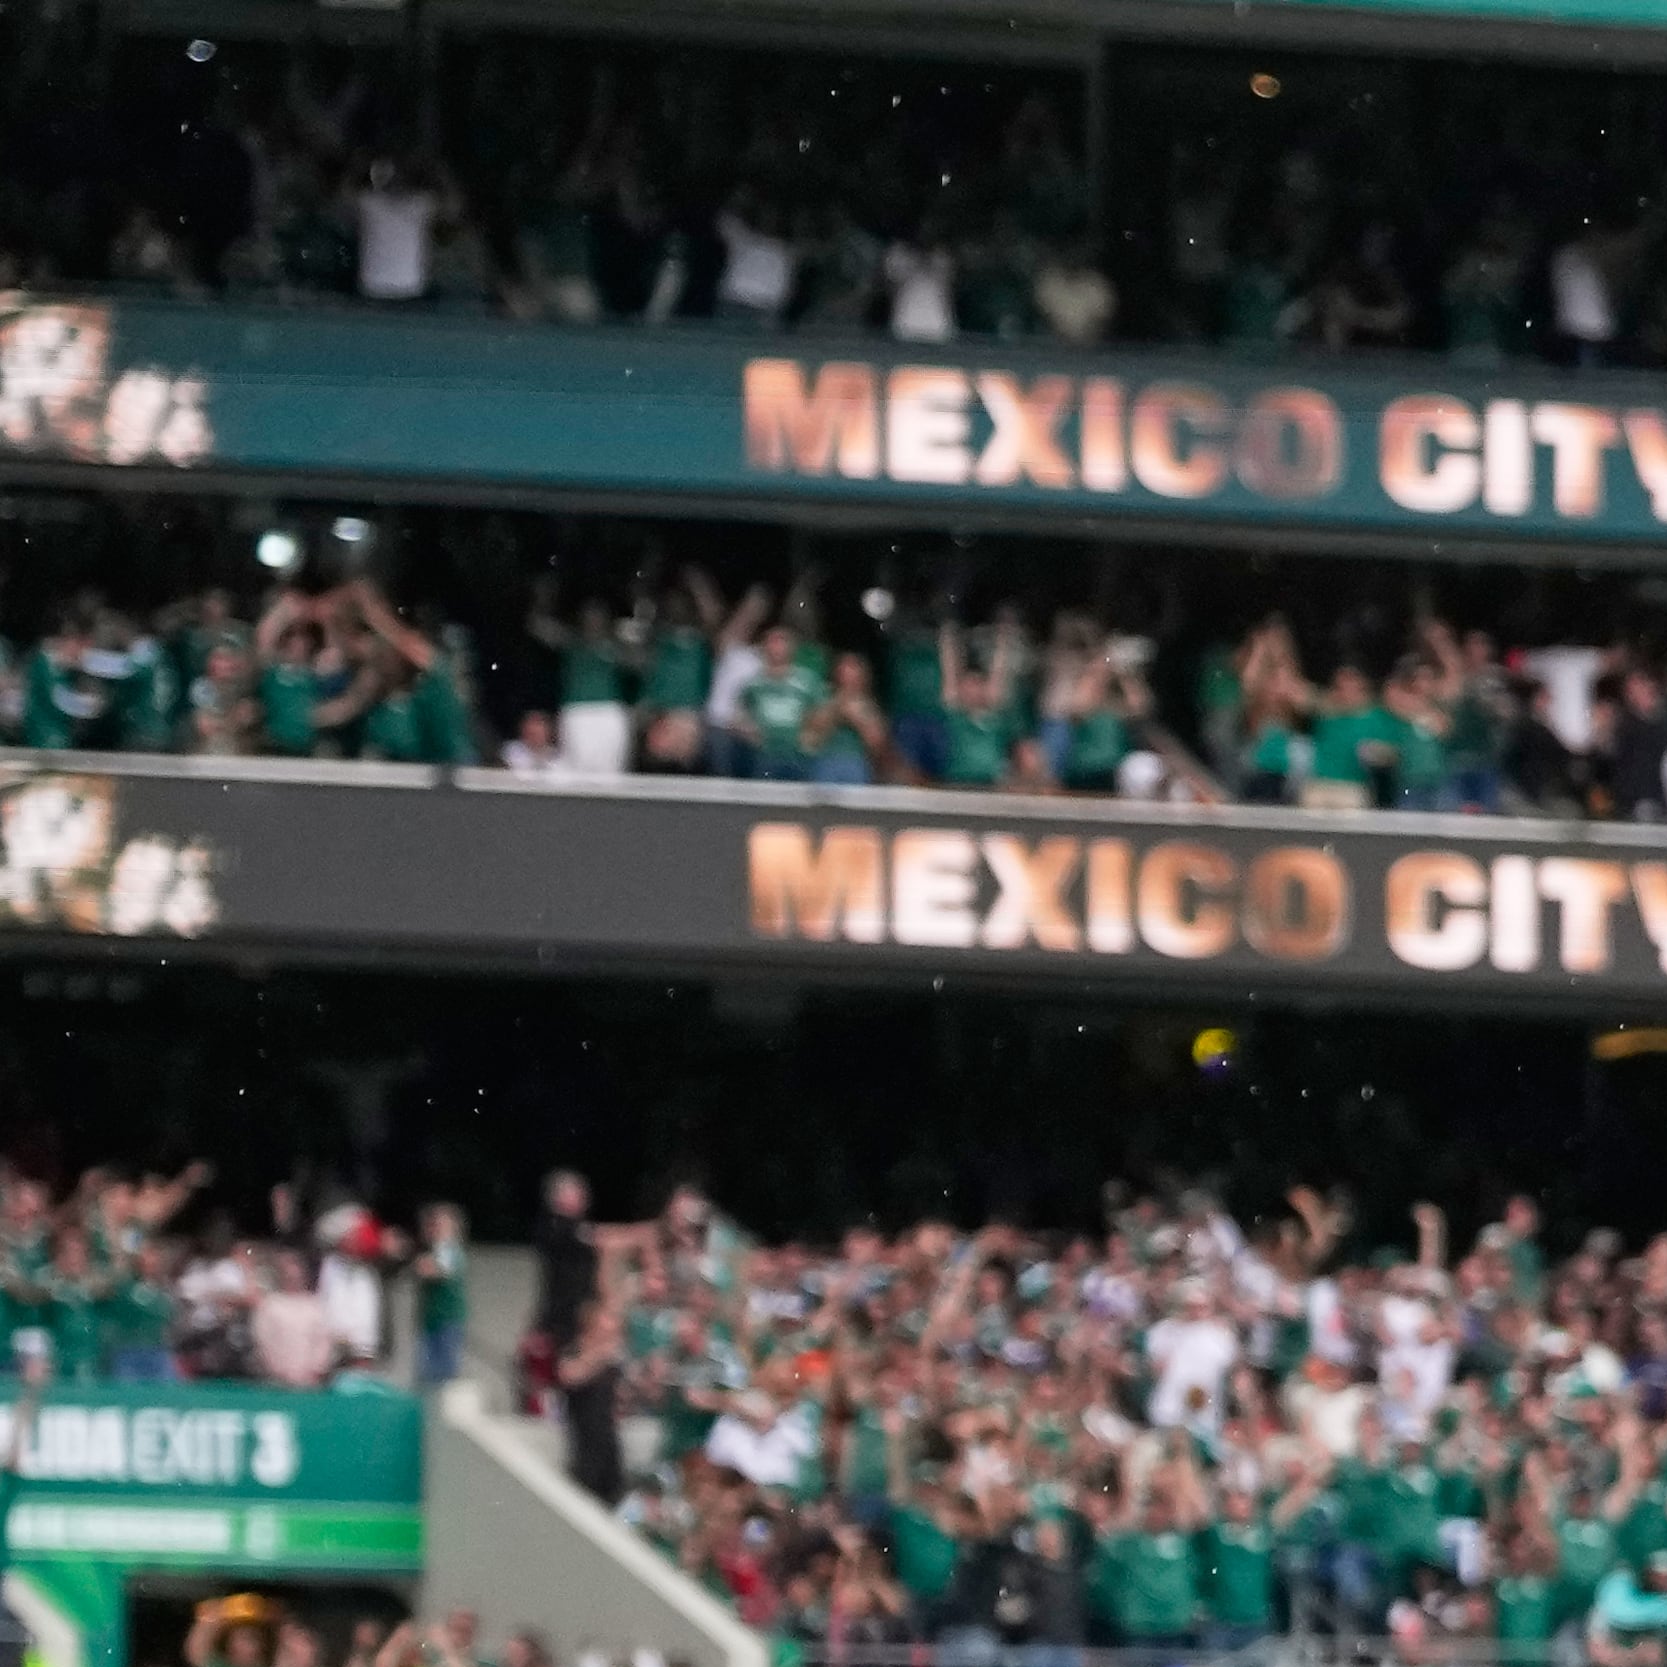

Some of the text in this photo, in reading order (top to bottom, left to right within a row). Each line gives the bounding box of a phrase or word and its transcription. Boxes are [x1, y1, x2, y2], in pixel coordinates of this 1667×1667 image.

[743, 358, 1343, 500] MEXICO
[747, 823, 1348, 961] MEXICO
[130, 1406, 243, 1486] EXIT
[250, 1410, 296, 1488] 3
